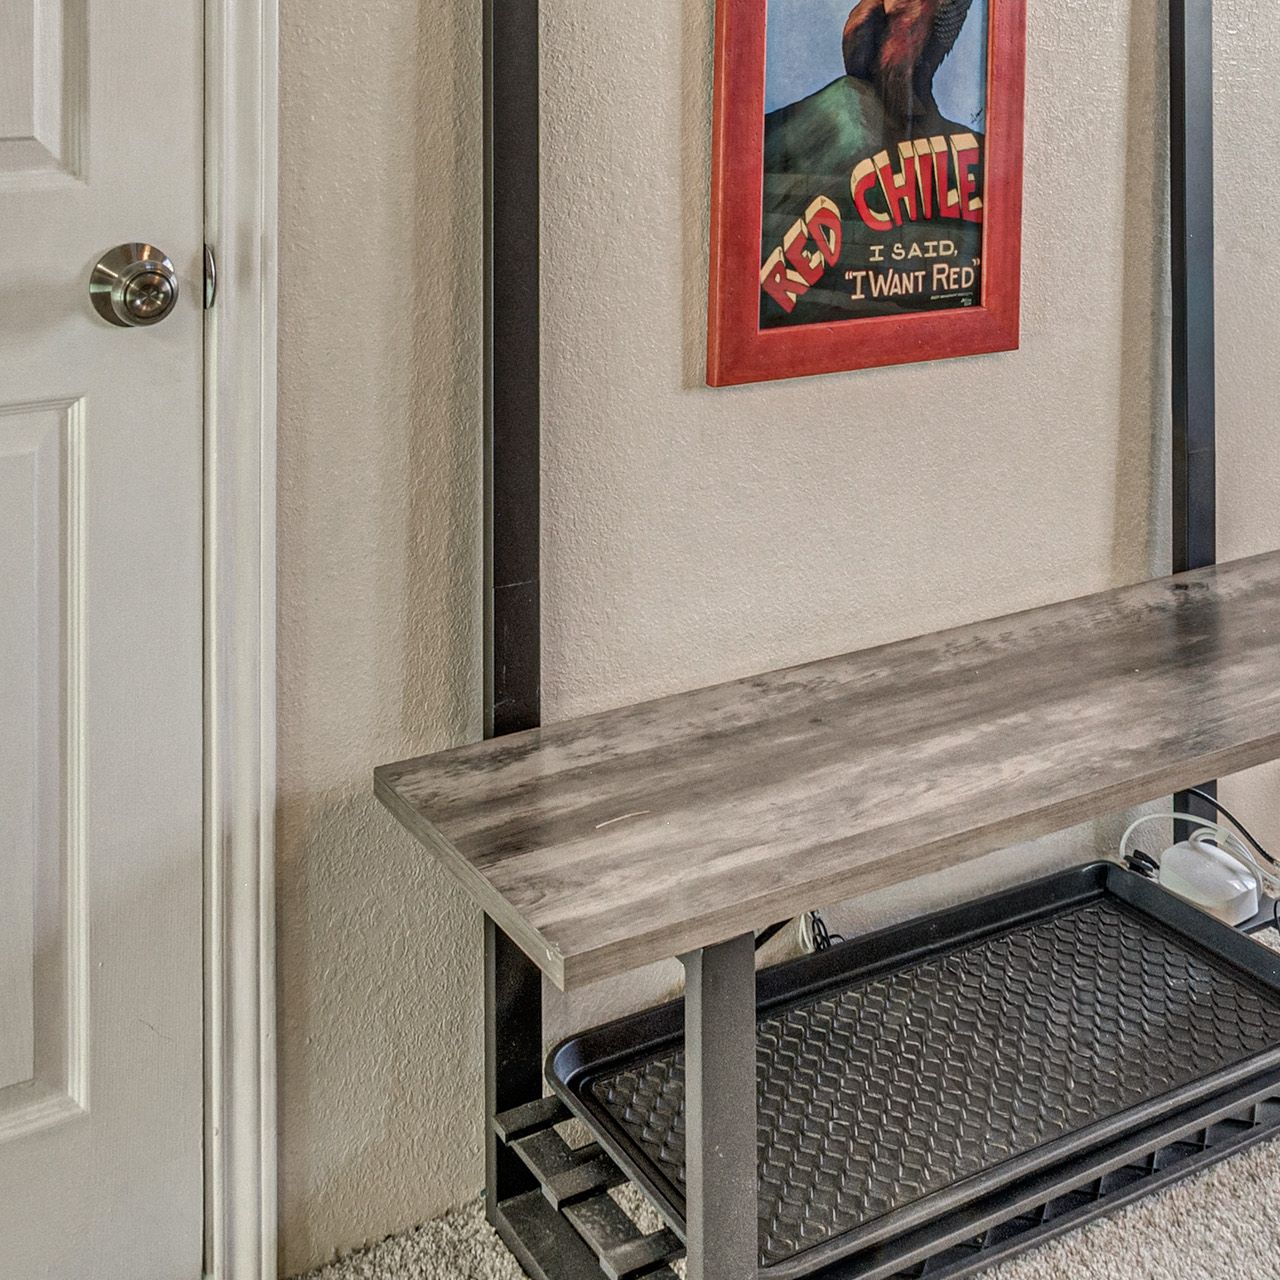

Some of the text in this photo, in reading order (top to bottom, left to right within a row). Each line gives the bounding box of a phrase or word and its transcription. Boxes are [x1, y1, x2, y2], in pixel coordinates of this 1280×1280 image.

[760, 133, 983, 314] RED CHILE
[869, 240, 958, 262] I SAID,
[869, 269, 926, 297] WANT
